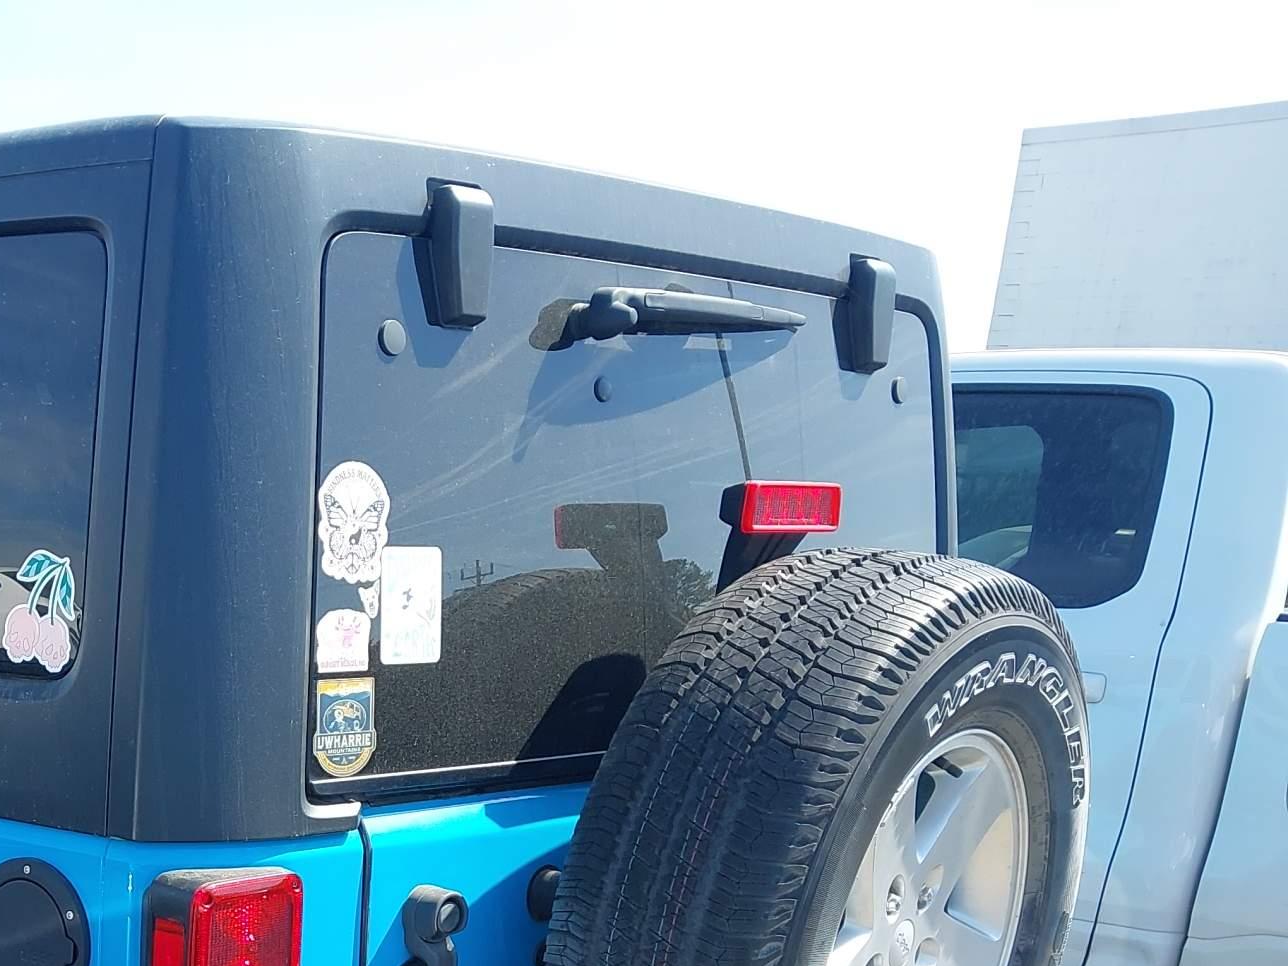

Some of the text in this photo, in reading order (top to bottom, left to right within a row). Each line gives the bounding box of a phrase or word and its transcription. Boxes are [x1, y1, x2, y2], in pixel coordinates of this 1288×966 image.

[326, 467, 355, 495] KINDNESS
[925, 651, 1088, 809] WRANGLER
[317, 733, 372, 750] UWHARRIE
[327, 746, 361, 754] MOUNTAINS
